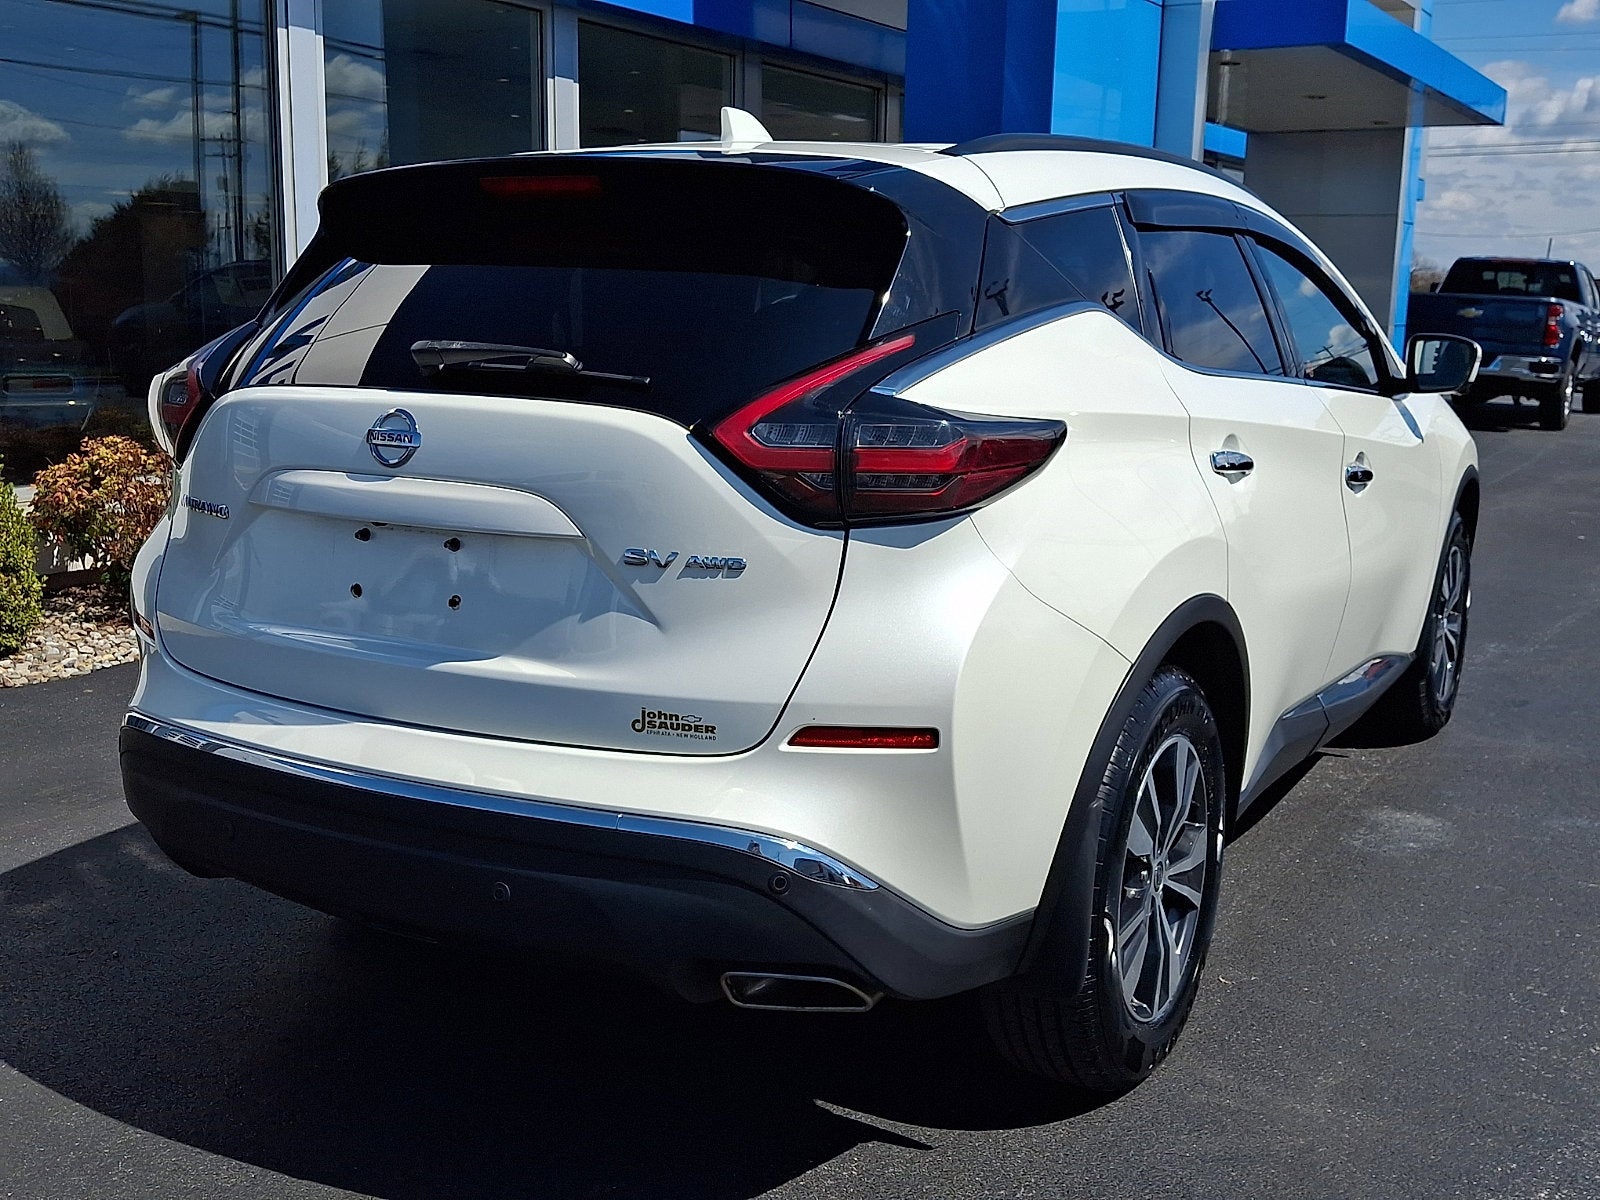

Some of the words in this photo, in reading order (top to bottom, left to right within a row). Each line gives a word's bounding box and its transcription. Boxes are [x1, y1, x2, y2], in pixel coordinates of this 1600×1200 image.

[369, 431, 414, 444] NISSAN
[624, 548, 680, 568] SV
[685, 555, 748, 570] AWD
[631, 706, 680, 733] john
[646, 720, 717, 734] SAUDER
[646, 729, 671, 737] EPHRATA
[690, 733, 717, 741] HOLLAND
